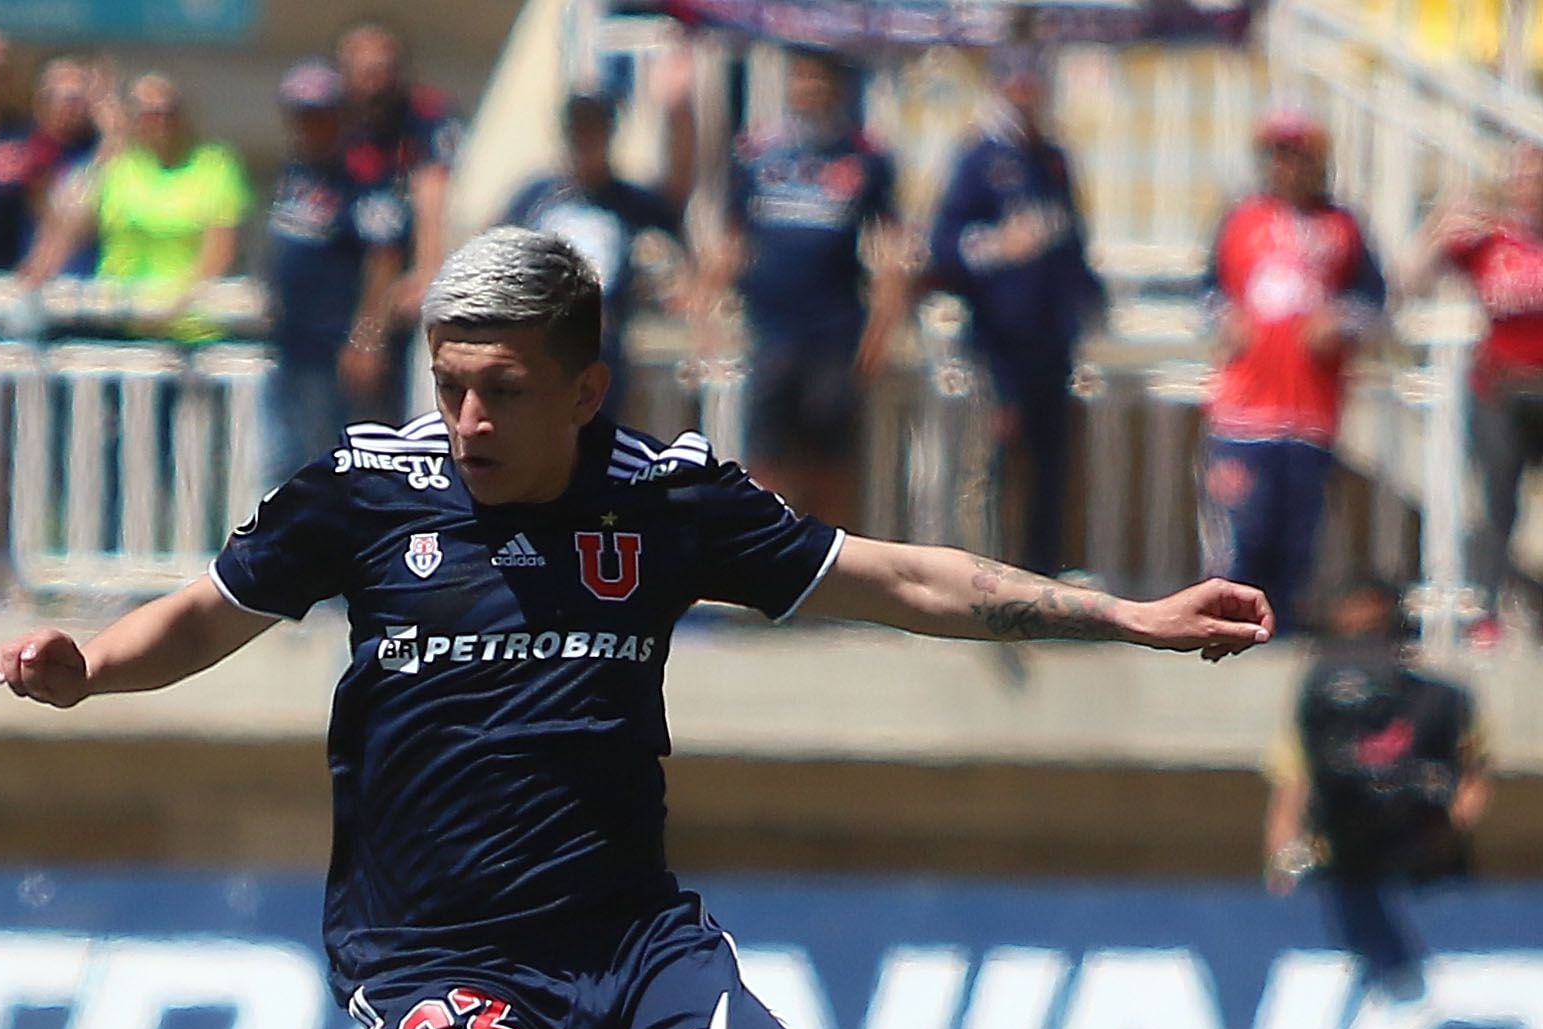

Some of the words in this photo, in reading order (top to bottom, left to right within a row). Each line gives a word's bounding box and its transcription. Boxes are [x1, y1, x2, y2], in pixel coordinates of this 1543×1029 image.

[334, 449, 444, 475] DIRECTV
[408, 471, 451, 490] GO
[491, 554, 547, 567] adidas
[574, 531, 643, 601] U
[423, 631, 655, 663] PETROBRAS
